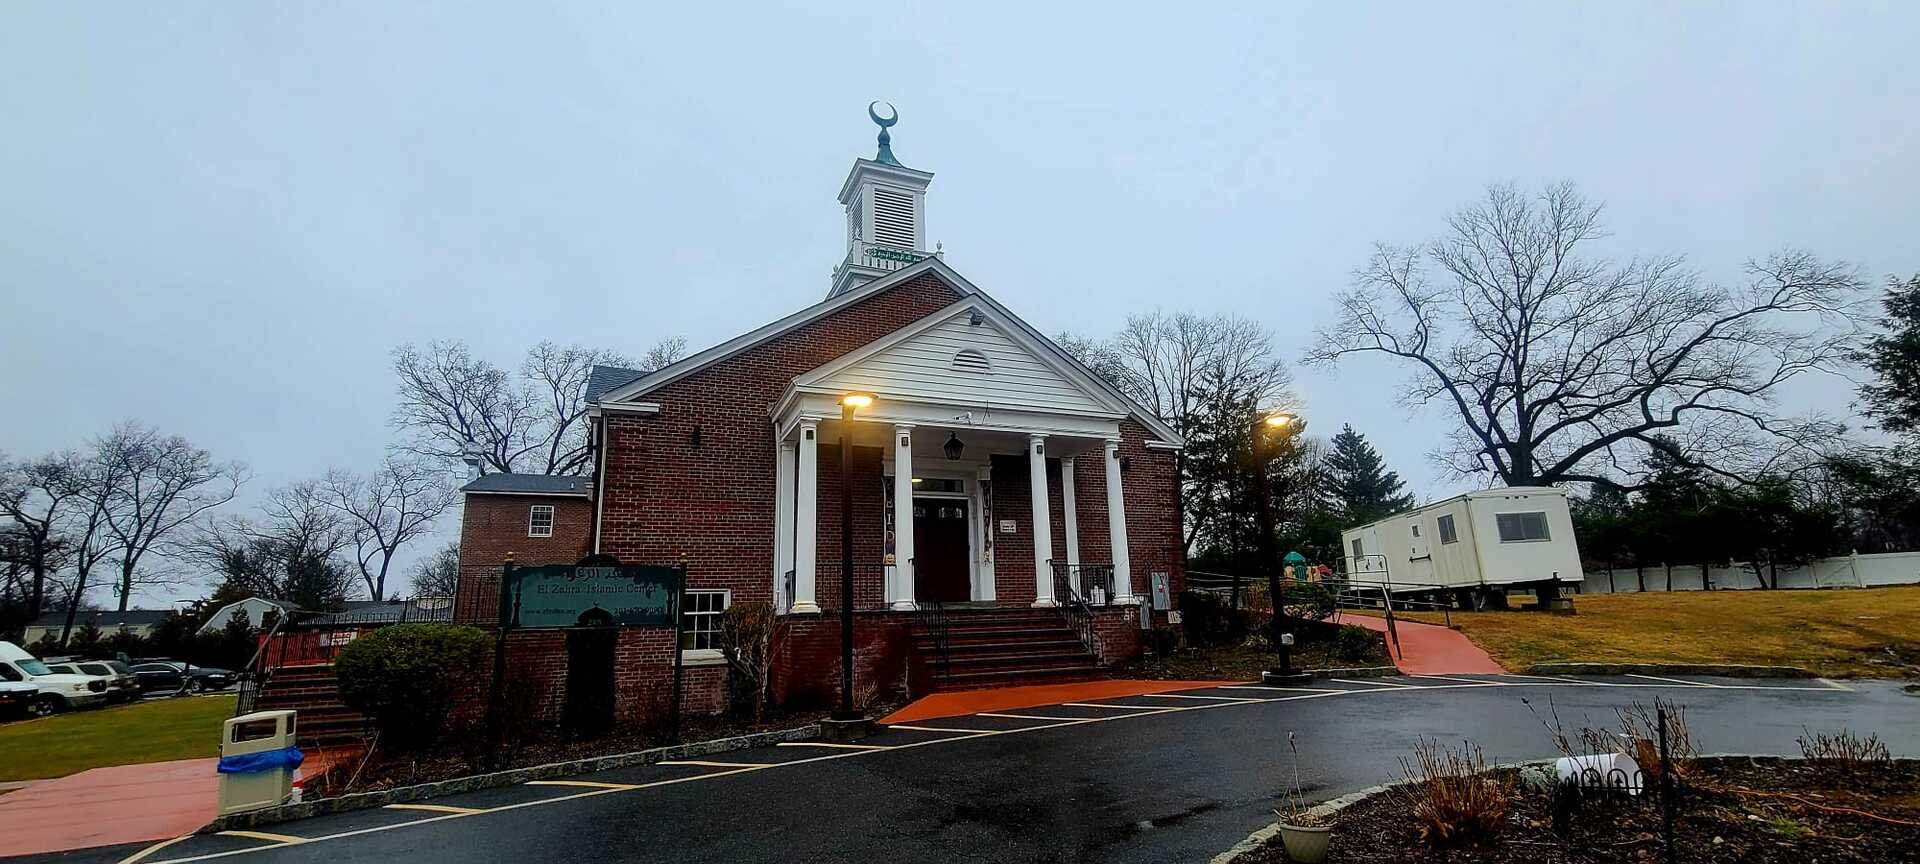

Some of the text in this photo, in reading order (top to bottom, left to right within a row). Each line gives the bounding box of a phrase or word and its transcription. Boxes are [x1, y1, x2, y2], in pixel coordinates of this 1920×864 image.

[538, 583, 656, 594] El Zahra Islamic Center
